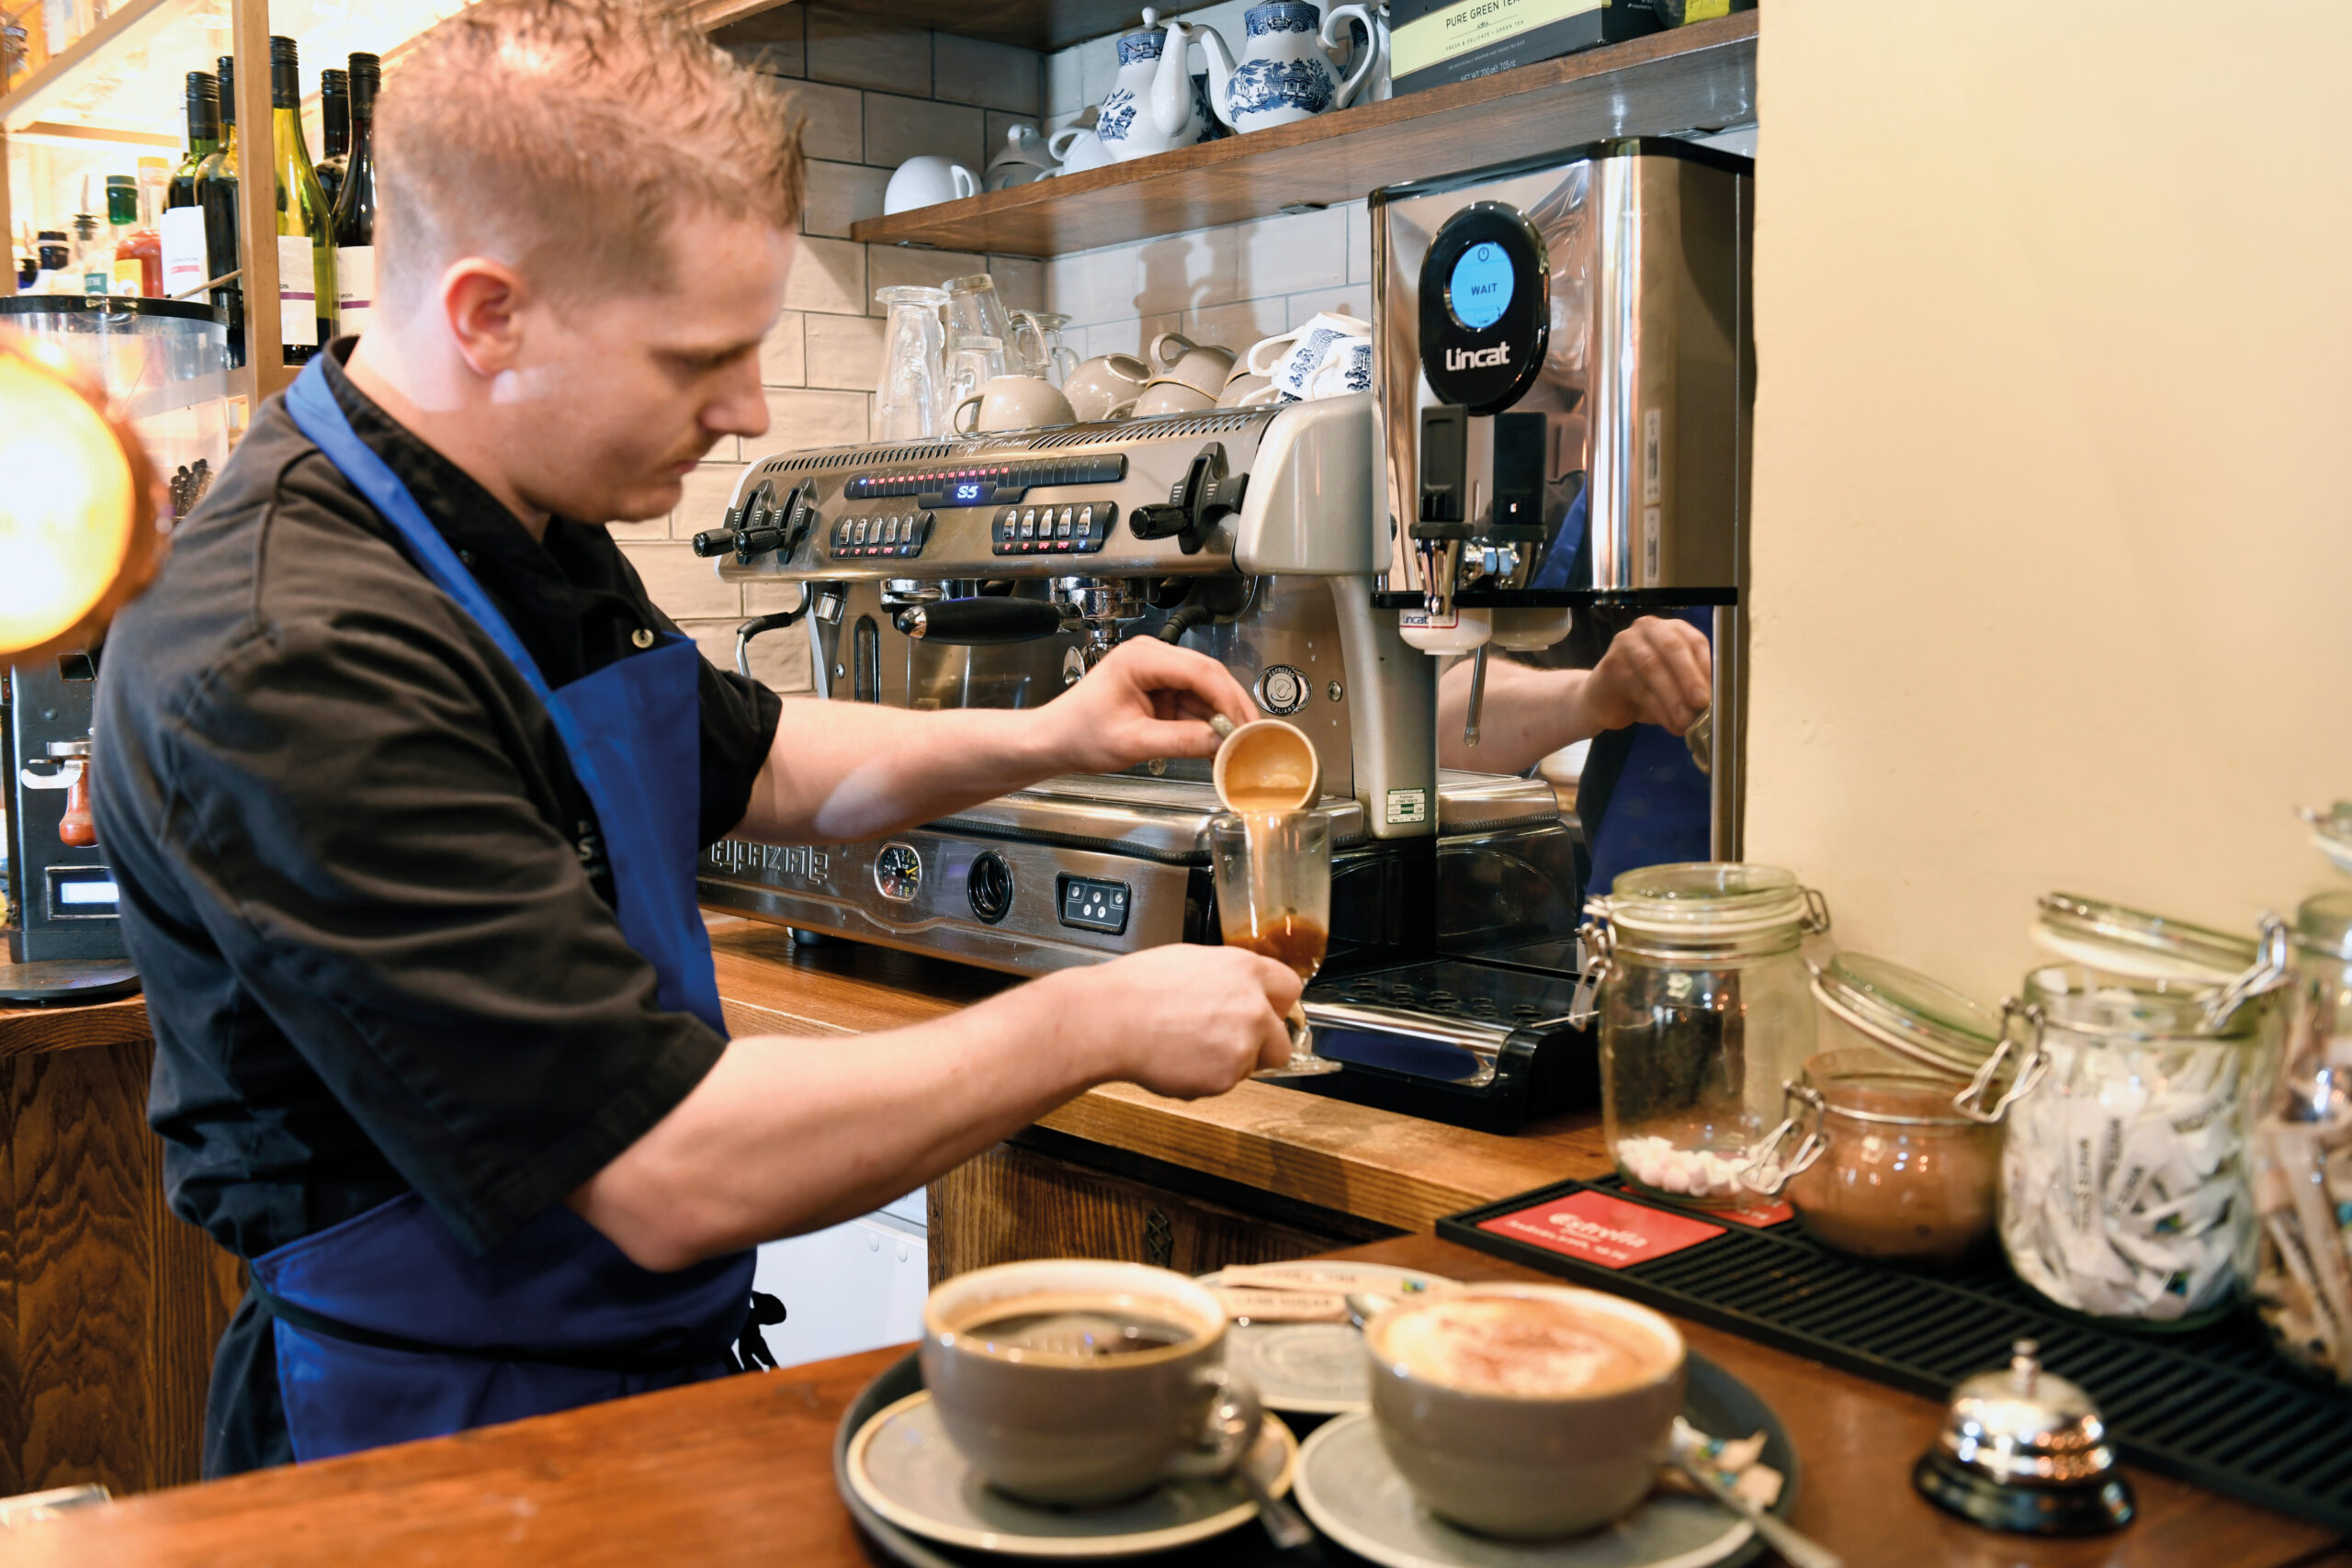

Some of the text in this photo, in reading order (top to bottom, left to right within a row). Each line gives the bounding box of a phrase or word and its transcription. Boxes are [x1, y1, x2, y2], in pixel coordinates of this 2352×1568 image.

[1446, 12, 1468, 29] PURE
[1470, 1, 1499, 19] GREEN
[1446, 43, 1460, 51] FRESH
[1467, 32, 1489, 44] DELICATE
[1496, 24, 1512, 33] GREEN
[1471, 71, 1479, 79] WT
[1471, 283, 1497, 296] WAIT
[1446, 341, 1510, 371] Lincat
[957, 485, 978, 498] S5
[1269, 667, 1295, 678] ESPRESSO
[1269, 704, 1295, 714] ITALIANO
